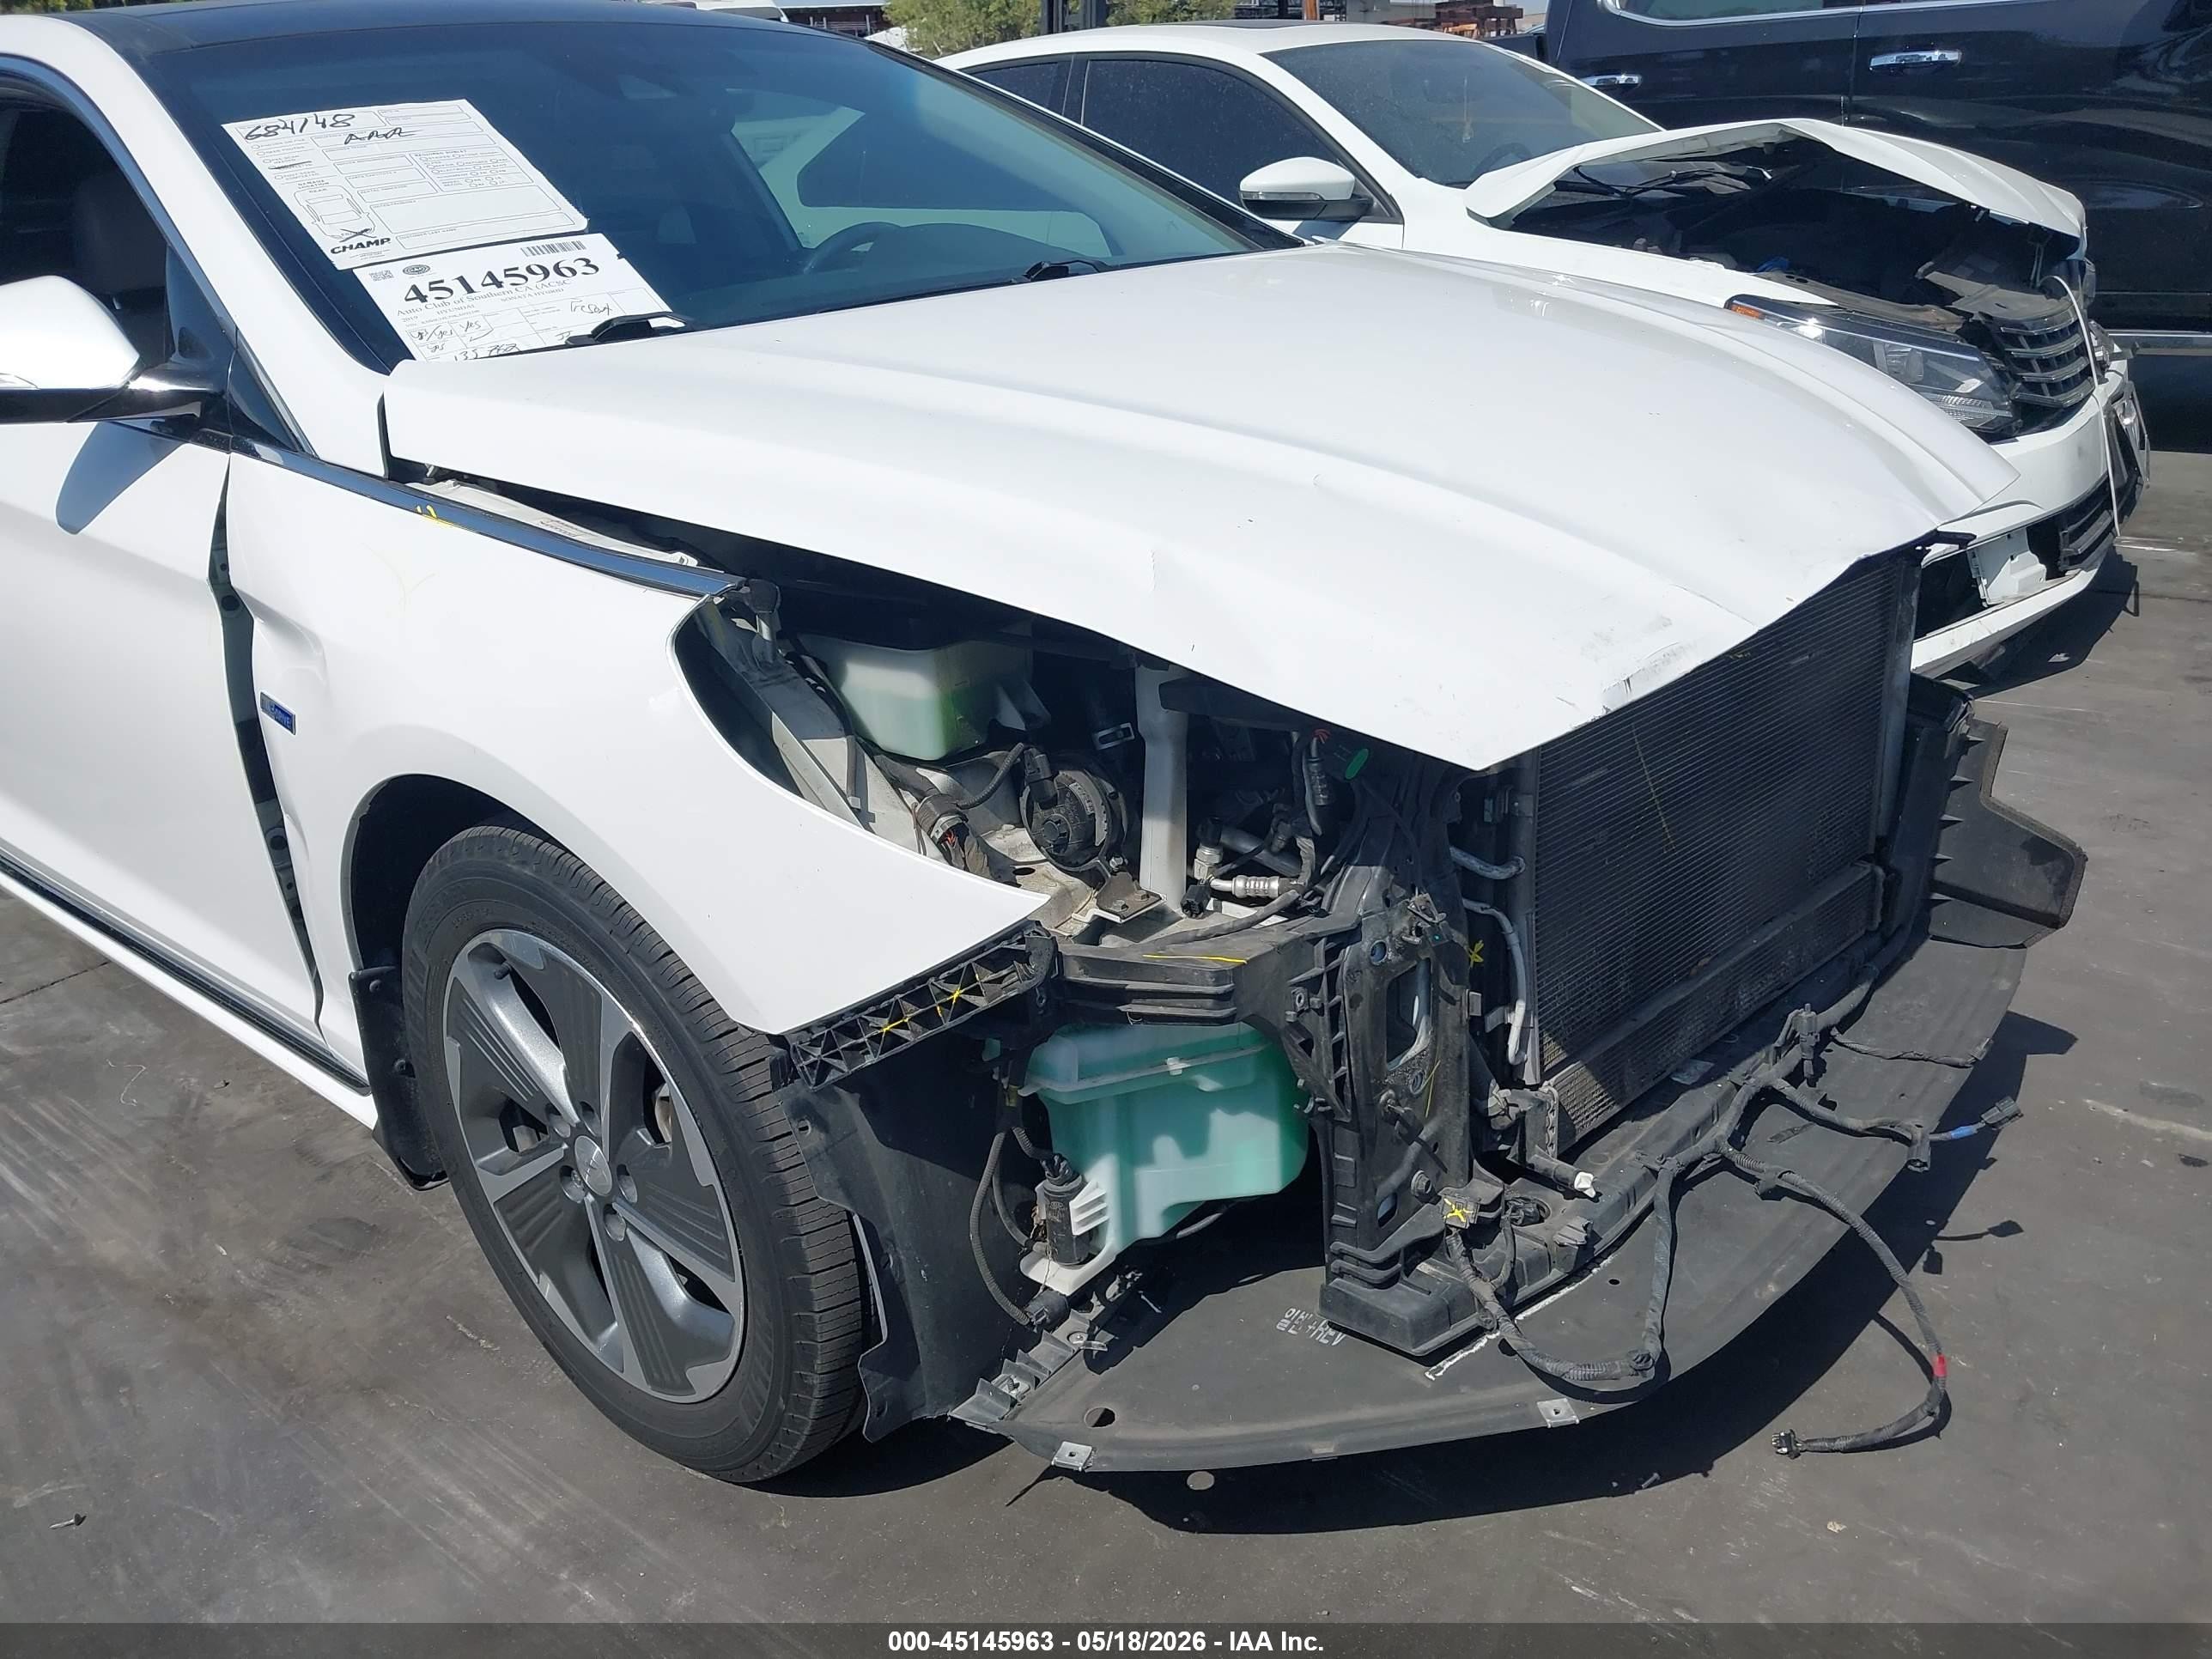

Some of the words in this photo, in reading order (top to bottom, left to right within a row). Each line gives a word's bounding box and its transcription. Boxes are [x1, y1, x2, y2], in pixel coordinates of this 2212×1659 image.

[404, 258, 599, 303] 45145963
[397, 307, 423, 317] Auto
[424, 299, 451, 310] Club
[453, 295, 465, 304] of
[468, 288, 514, 301] Southern
[514, 284, 534, 295] CA
[436, 304, 475, 315] HYUNDAI
